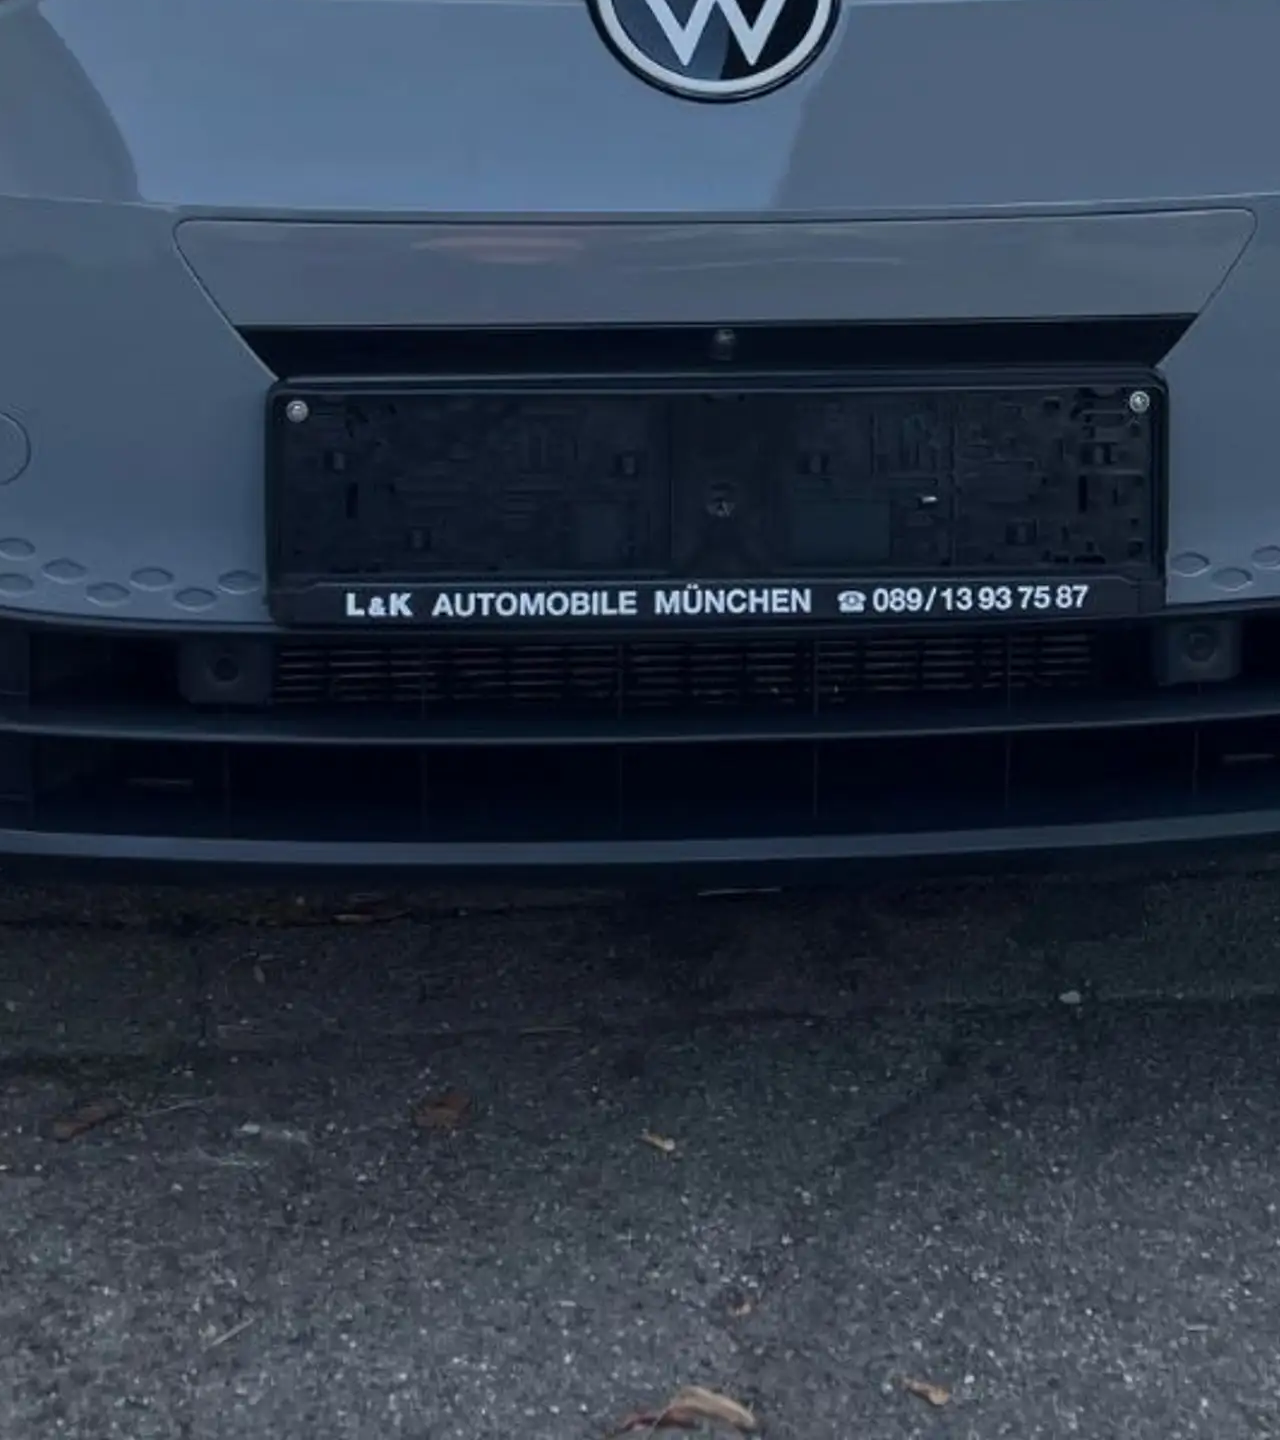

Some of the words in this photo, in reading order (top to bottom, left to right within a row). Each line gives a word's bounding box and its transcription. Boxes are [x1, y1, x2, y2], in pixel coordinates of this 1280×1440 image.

[346, 592, 412, 617] L&K
[431, 590, 638, 617] AUTOMOBILE
[654, 583, 812, 614] MÜNCHEN
